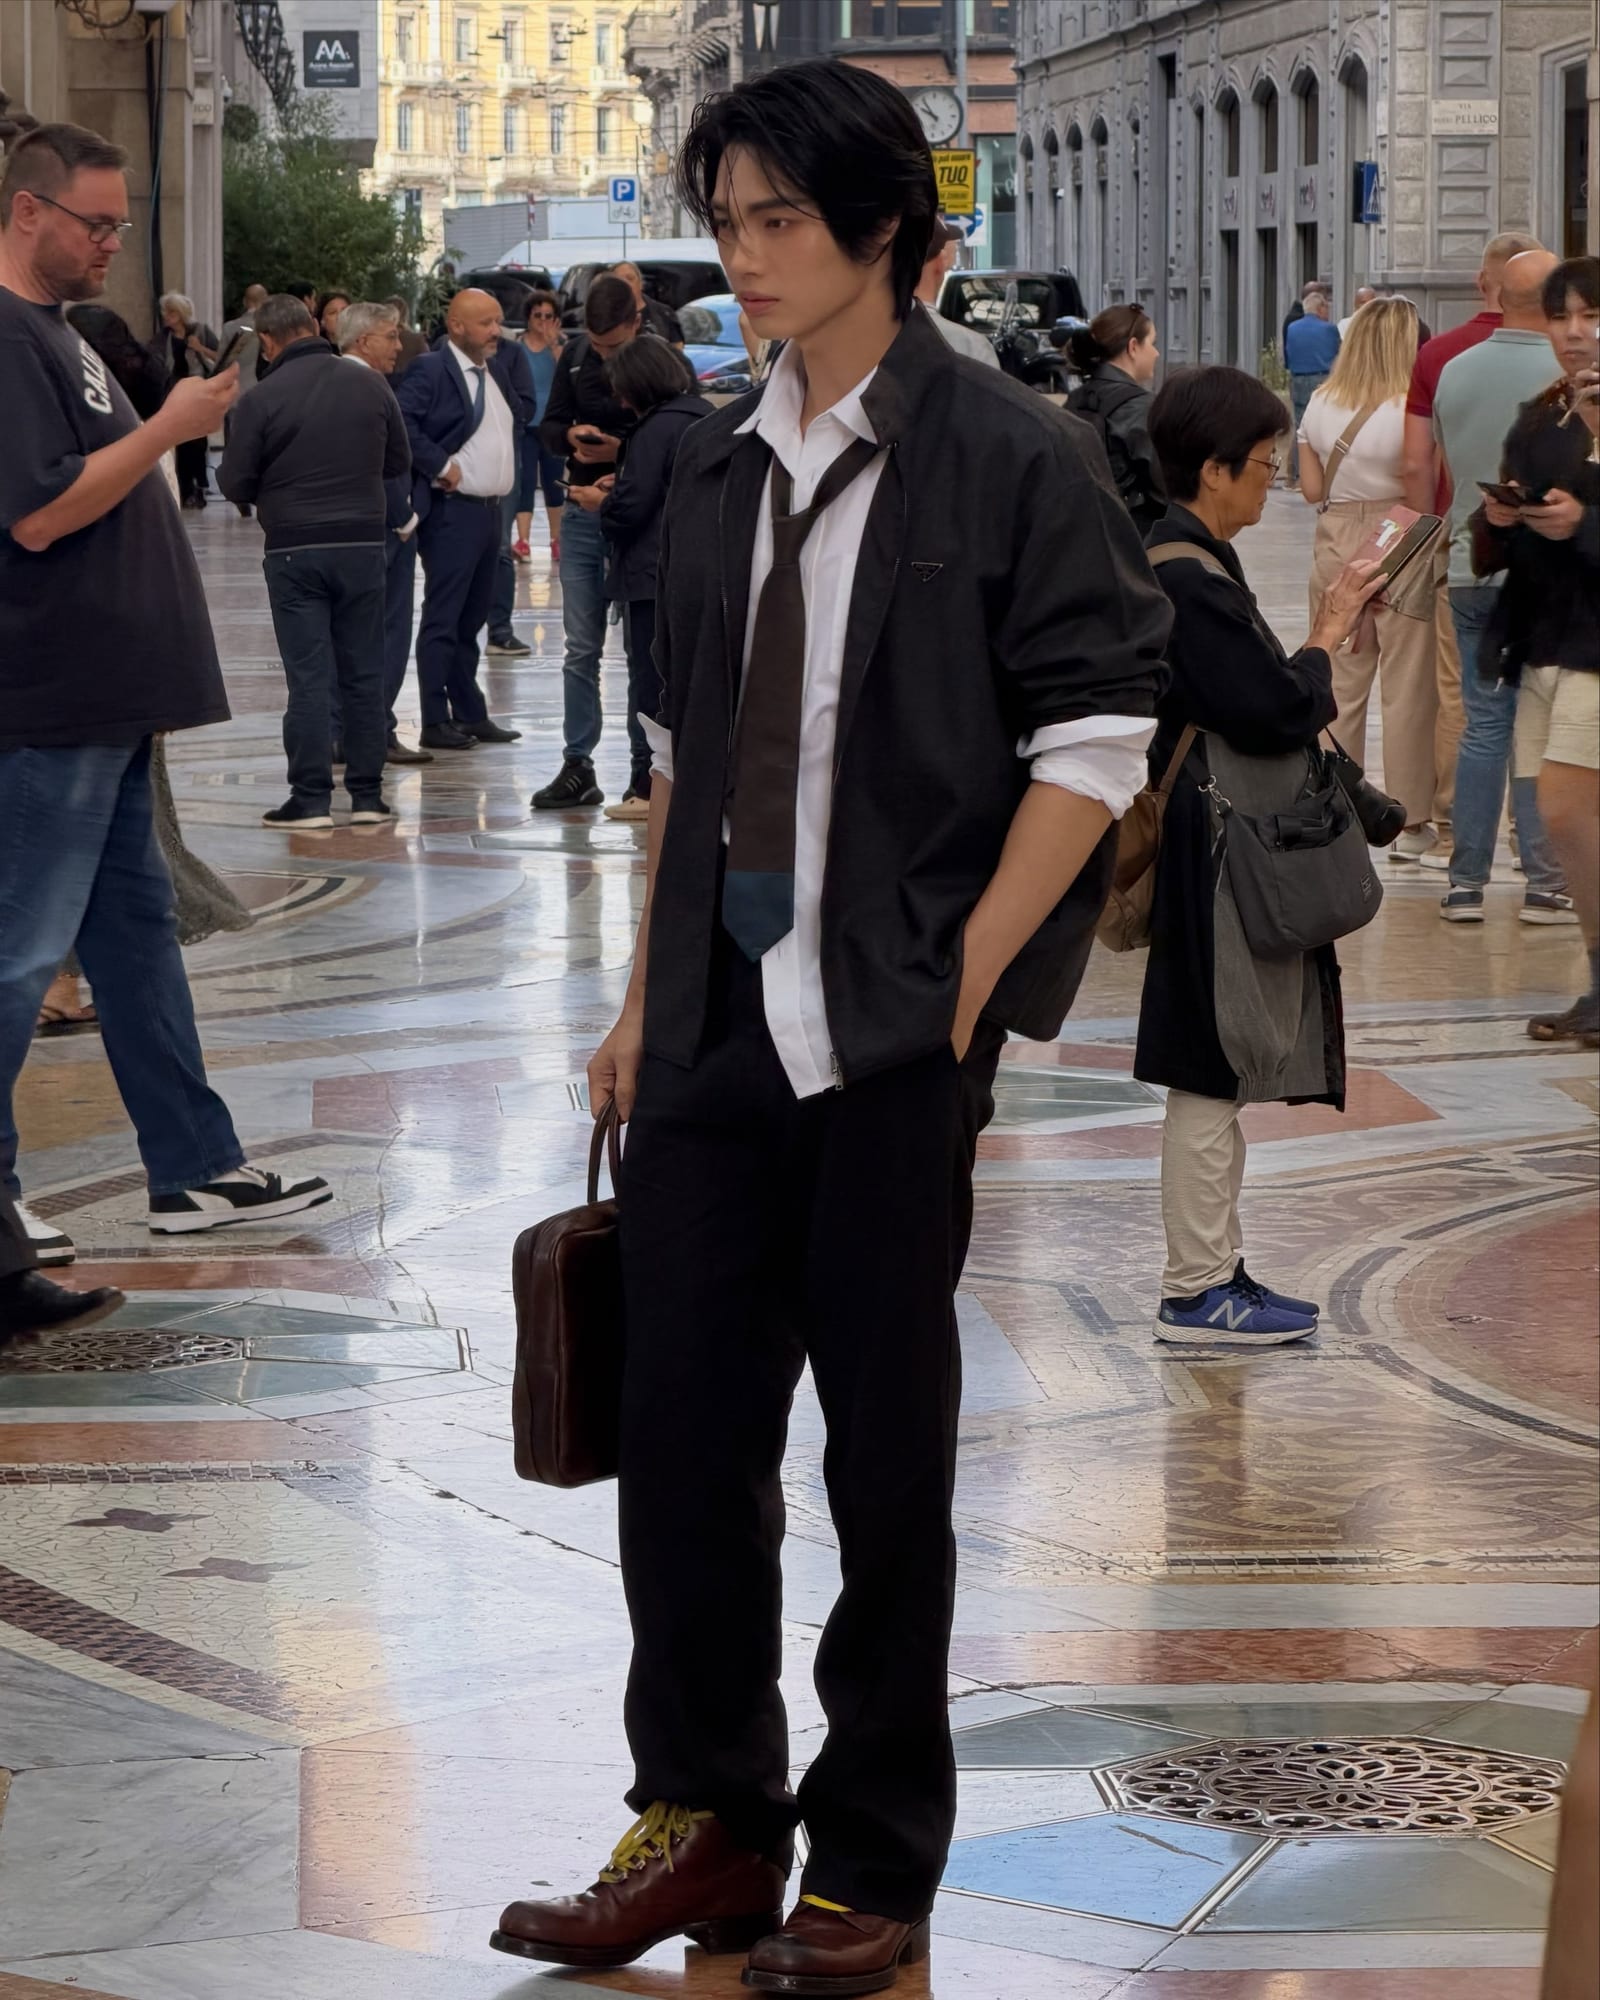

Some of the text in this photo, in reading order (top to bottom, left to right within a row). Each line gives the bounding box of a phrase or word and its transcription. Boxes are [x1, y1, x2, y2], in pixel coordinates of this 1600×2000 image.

[1455, 114, 1498, 125] PELLICO
[939, 165, 969, 184] TUO
[617, 181, 631, 200] P
[1207, 1299, 1253, 1330] N
